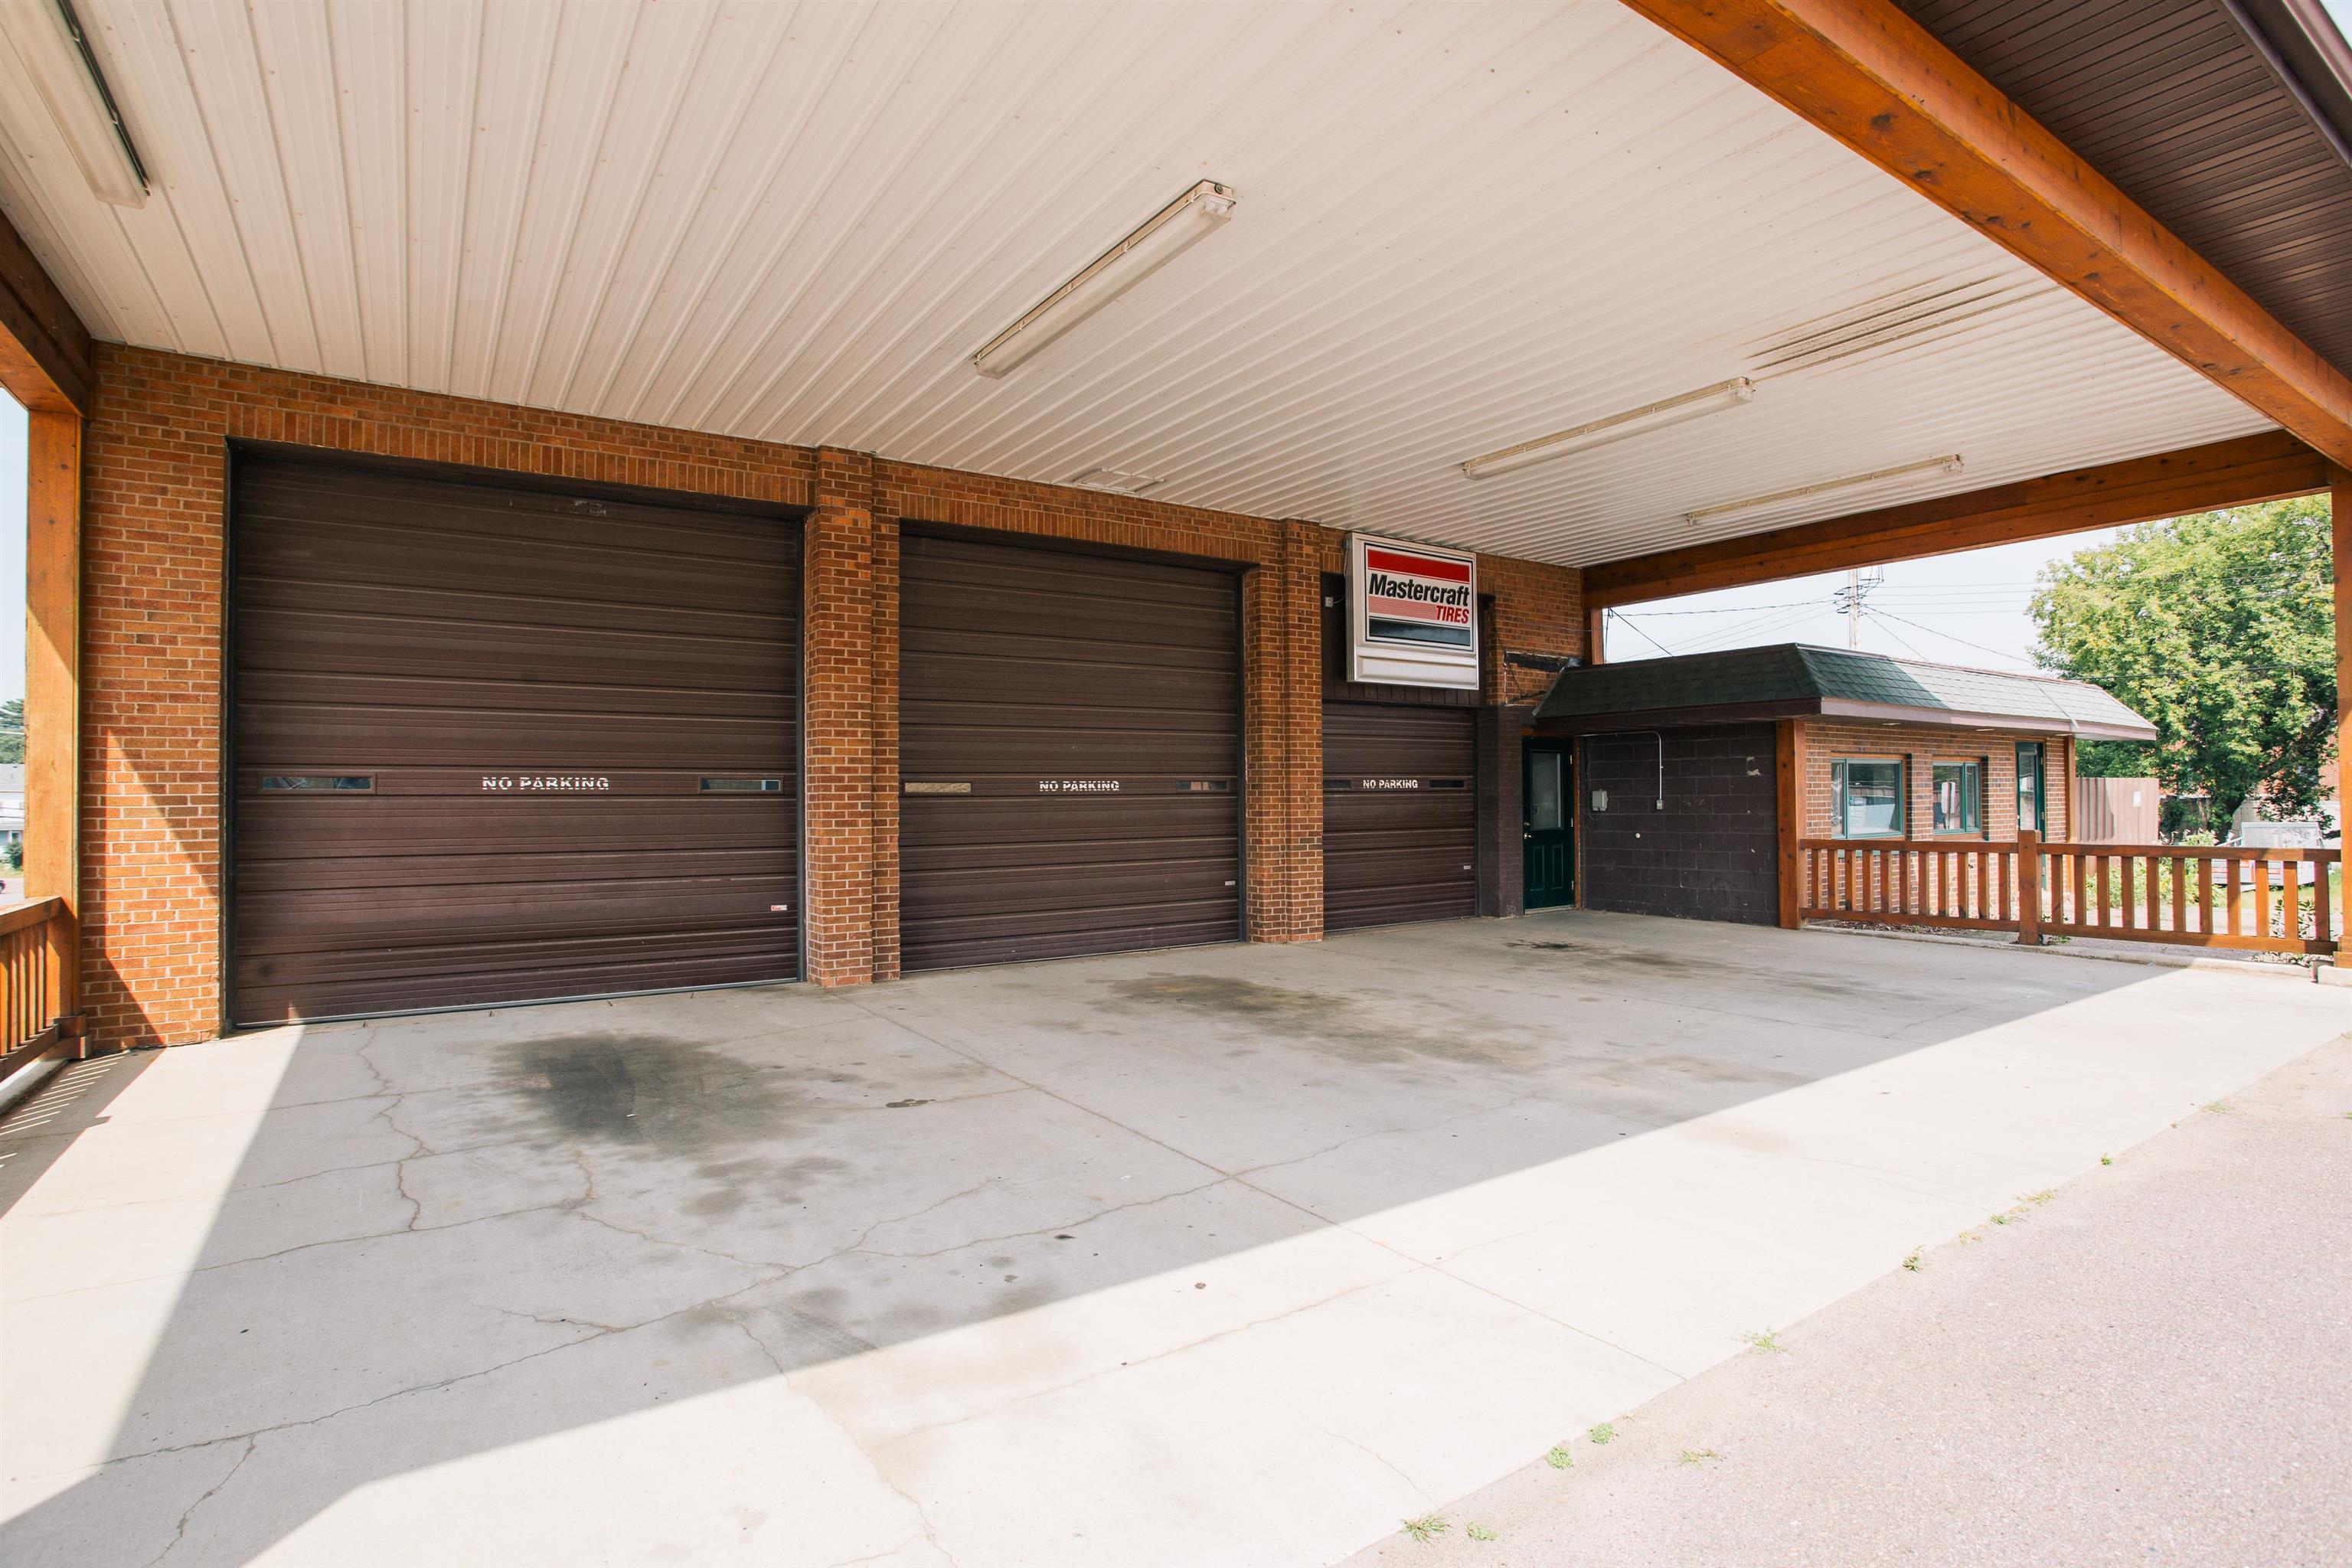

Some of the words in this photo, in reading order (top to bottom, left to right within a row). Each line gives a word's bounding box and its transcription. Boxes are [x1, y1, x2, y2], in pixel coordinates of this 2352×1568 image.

[1369, 573, 1470, 607] Mastercraft
[1436, 605, 1470, 625] TIRES
[482, 776, 512, 790] NO
[519, 776, 609, 790] PARKING
[1039, 780, 1059, 792] NO
[1063, 780, 1119, 792] PARKING
[1363, 779, 1377, 789] NO
[1379, 779, 1419, 789] PARKING
